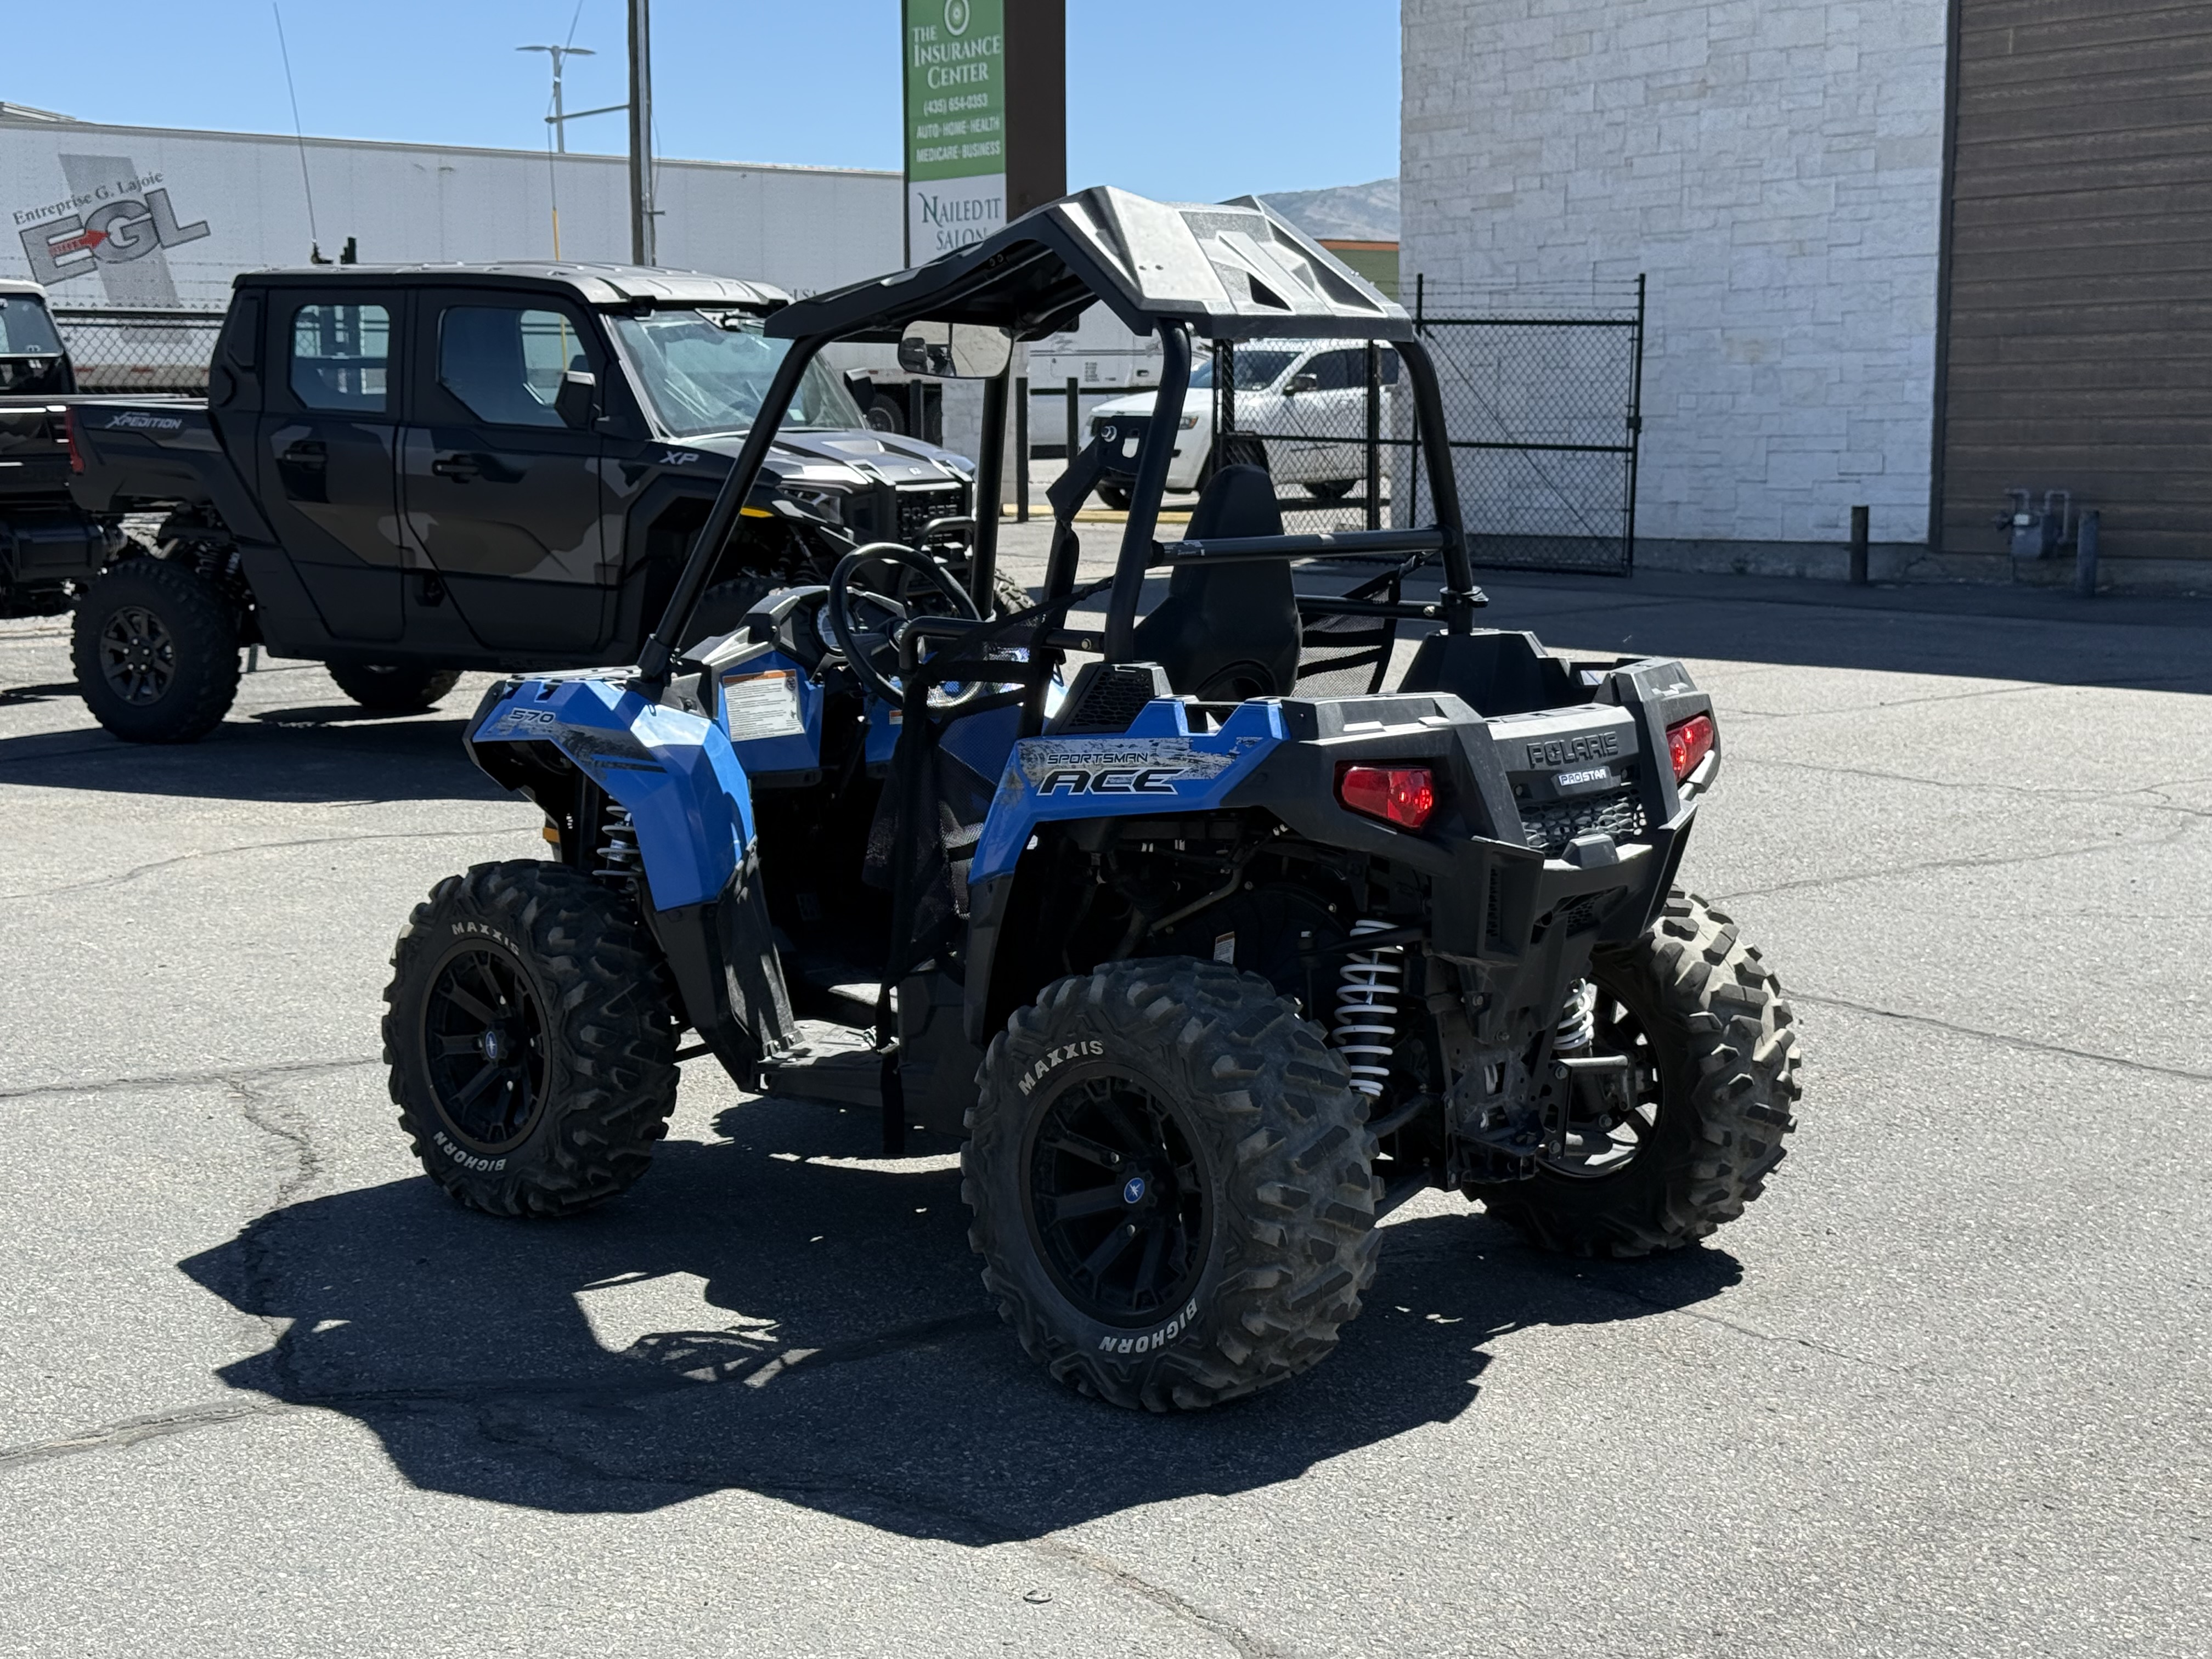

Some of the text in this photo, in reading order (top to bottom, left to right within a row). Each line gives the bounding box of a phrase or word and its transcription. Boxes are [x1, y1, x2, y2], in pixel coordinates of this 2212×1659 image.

[913, 25, 938, 43] THE
[914, 35, 1001, 68] INSURANCE
[928, 62, 989, 89] CENTER
[916, 116, 1000, 139] AUTO HOME HEALTH
[916, 139, 1001, 162] MEDICARE BUSINESS
[12, 193, 92, 225] Entreprise
[116, 170, 164, 193] Lajoie
[19, 188, 211, 286] EGL
[105, 411, 182, 430] XPEDITION
[659, 450, 699, 465] XP
[507, 707, 556, 724] 570
[1047, 752, 1149, 765] SPORTSMAN
[1527, 731, 1618, 769] POLARIS
[1036, 767, 1192, 796] ACE
[451, 922, 520, 956] MAXXIS
[1018, 1040, 1104, 1096] MAXXIS
[432, 1131, 507, 1172] BIGHORN
[1098, 1297, 1198, 1354] BIGHORN
